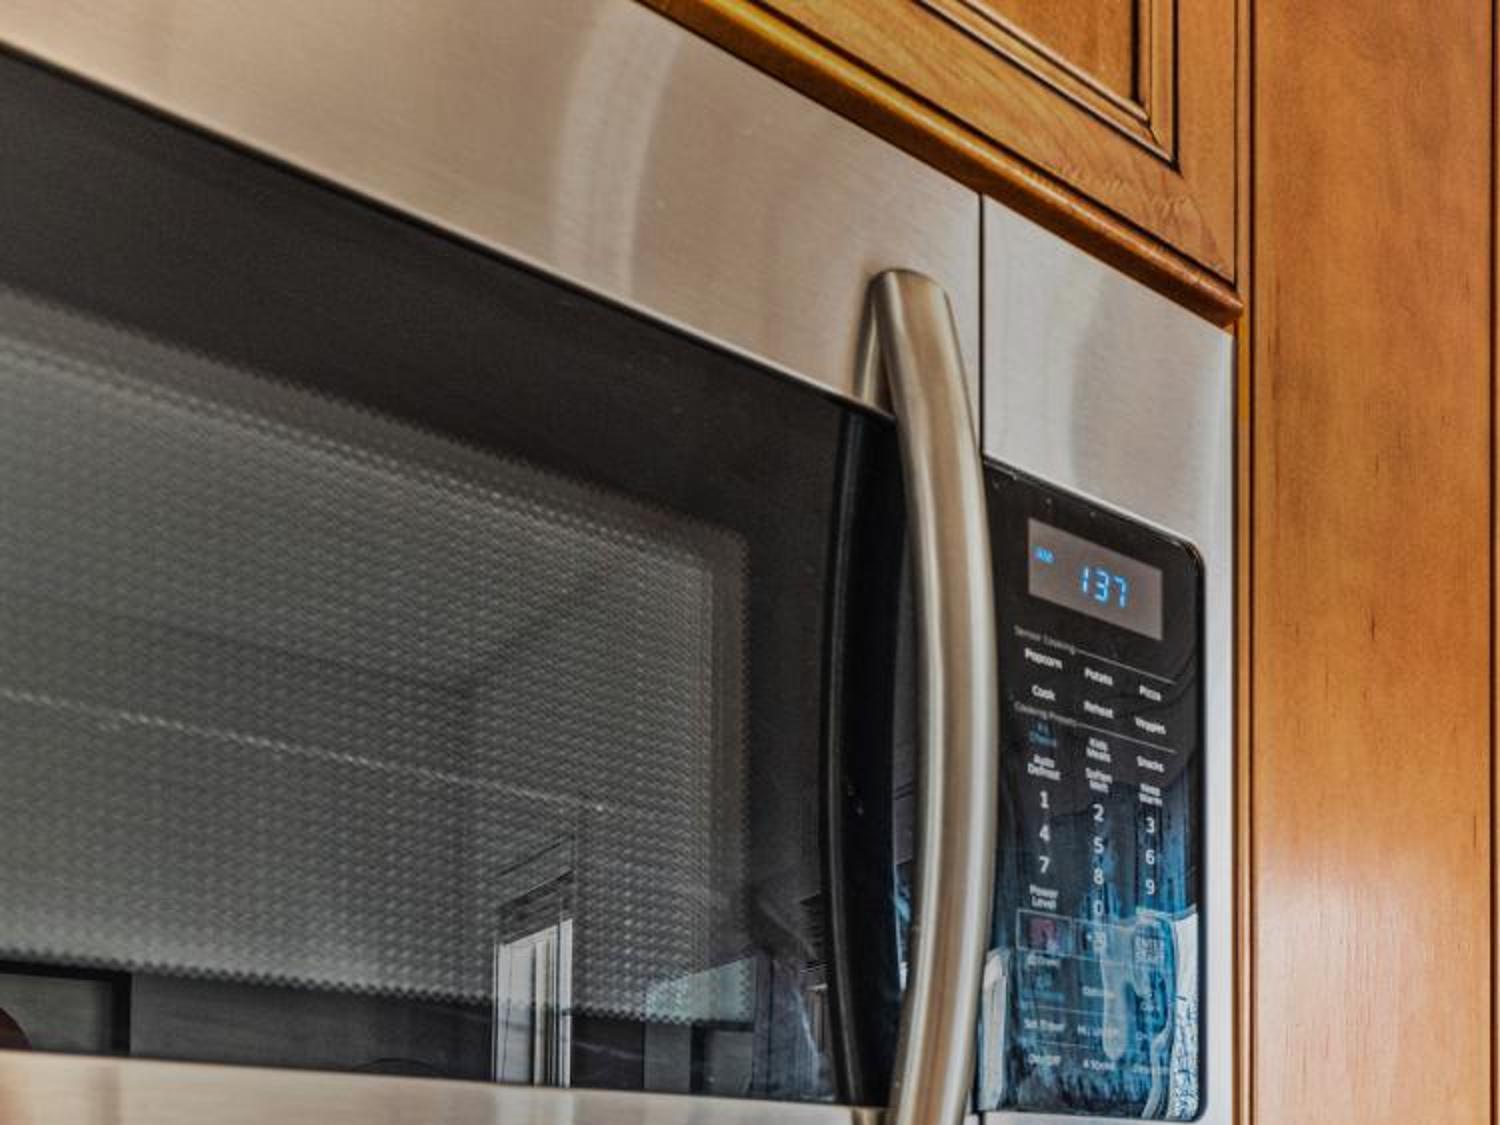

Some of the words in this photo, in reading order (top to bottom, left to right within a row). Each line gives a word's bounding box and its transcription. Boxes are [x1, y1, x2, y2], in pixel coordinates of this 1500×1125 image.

[1040, 791, 1049, 808] 1
[1093, 804, 1104, 823] 2
[1039, 824, 1050, 842] 4
[1145, 816, 1156, 833] 3
[1093, 837, 1104, 854] 5
[1039, 855, 1050, 874] 7
[1145, 849, 1156, 865] 6
[1093, 867, 1104, 885] 8
[1145, 878, 1156, 896] 9
